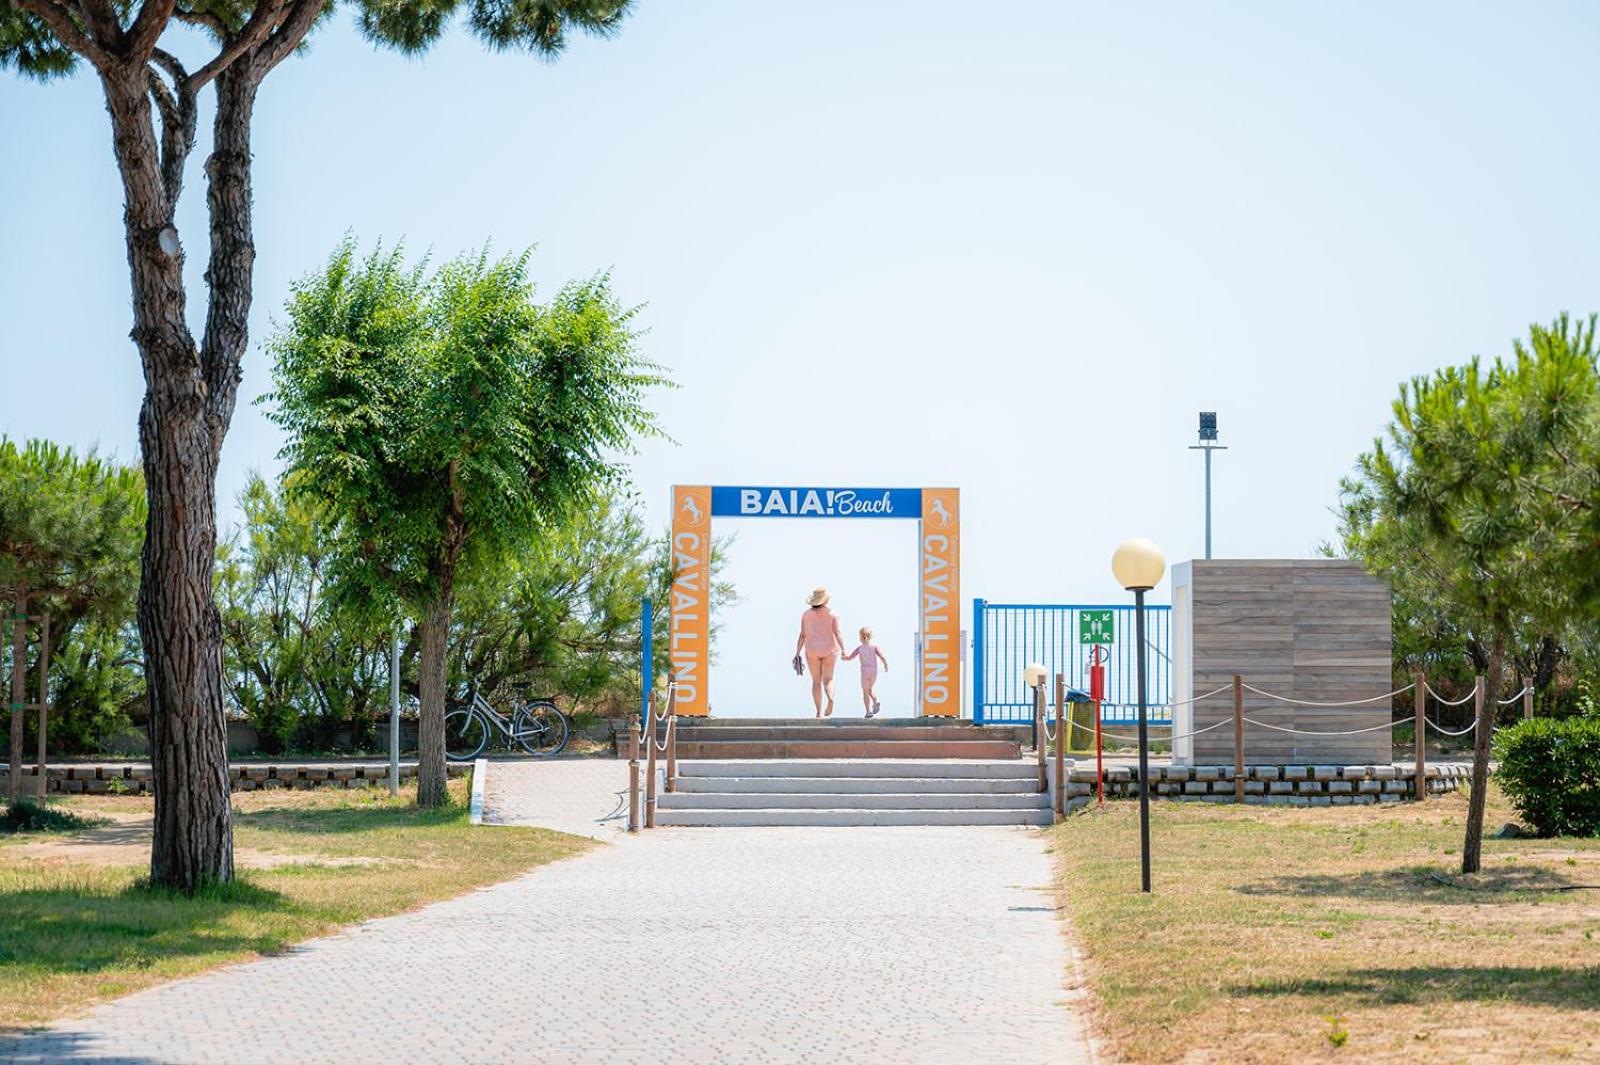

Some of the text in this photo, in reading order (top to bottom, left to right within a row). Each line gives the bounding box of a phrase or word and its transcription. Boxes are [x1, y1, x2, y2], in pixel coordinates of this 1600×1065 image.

[740, 489, 893, 515] BAIA! Beach
[671, 532, 699, 703] CAVALLINO
[924, 534, 948, 704] CAVALLINO
